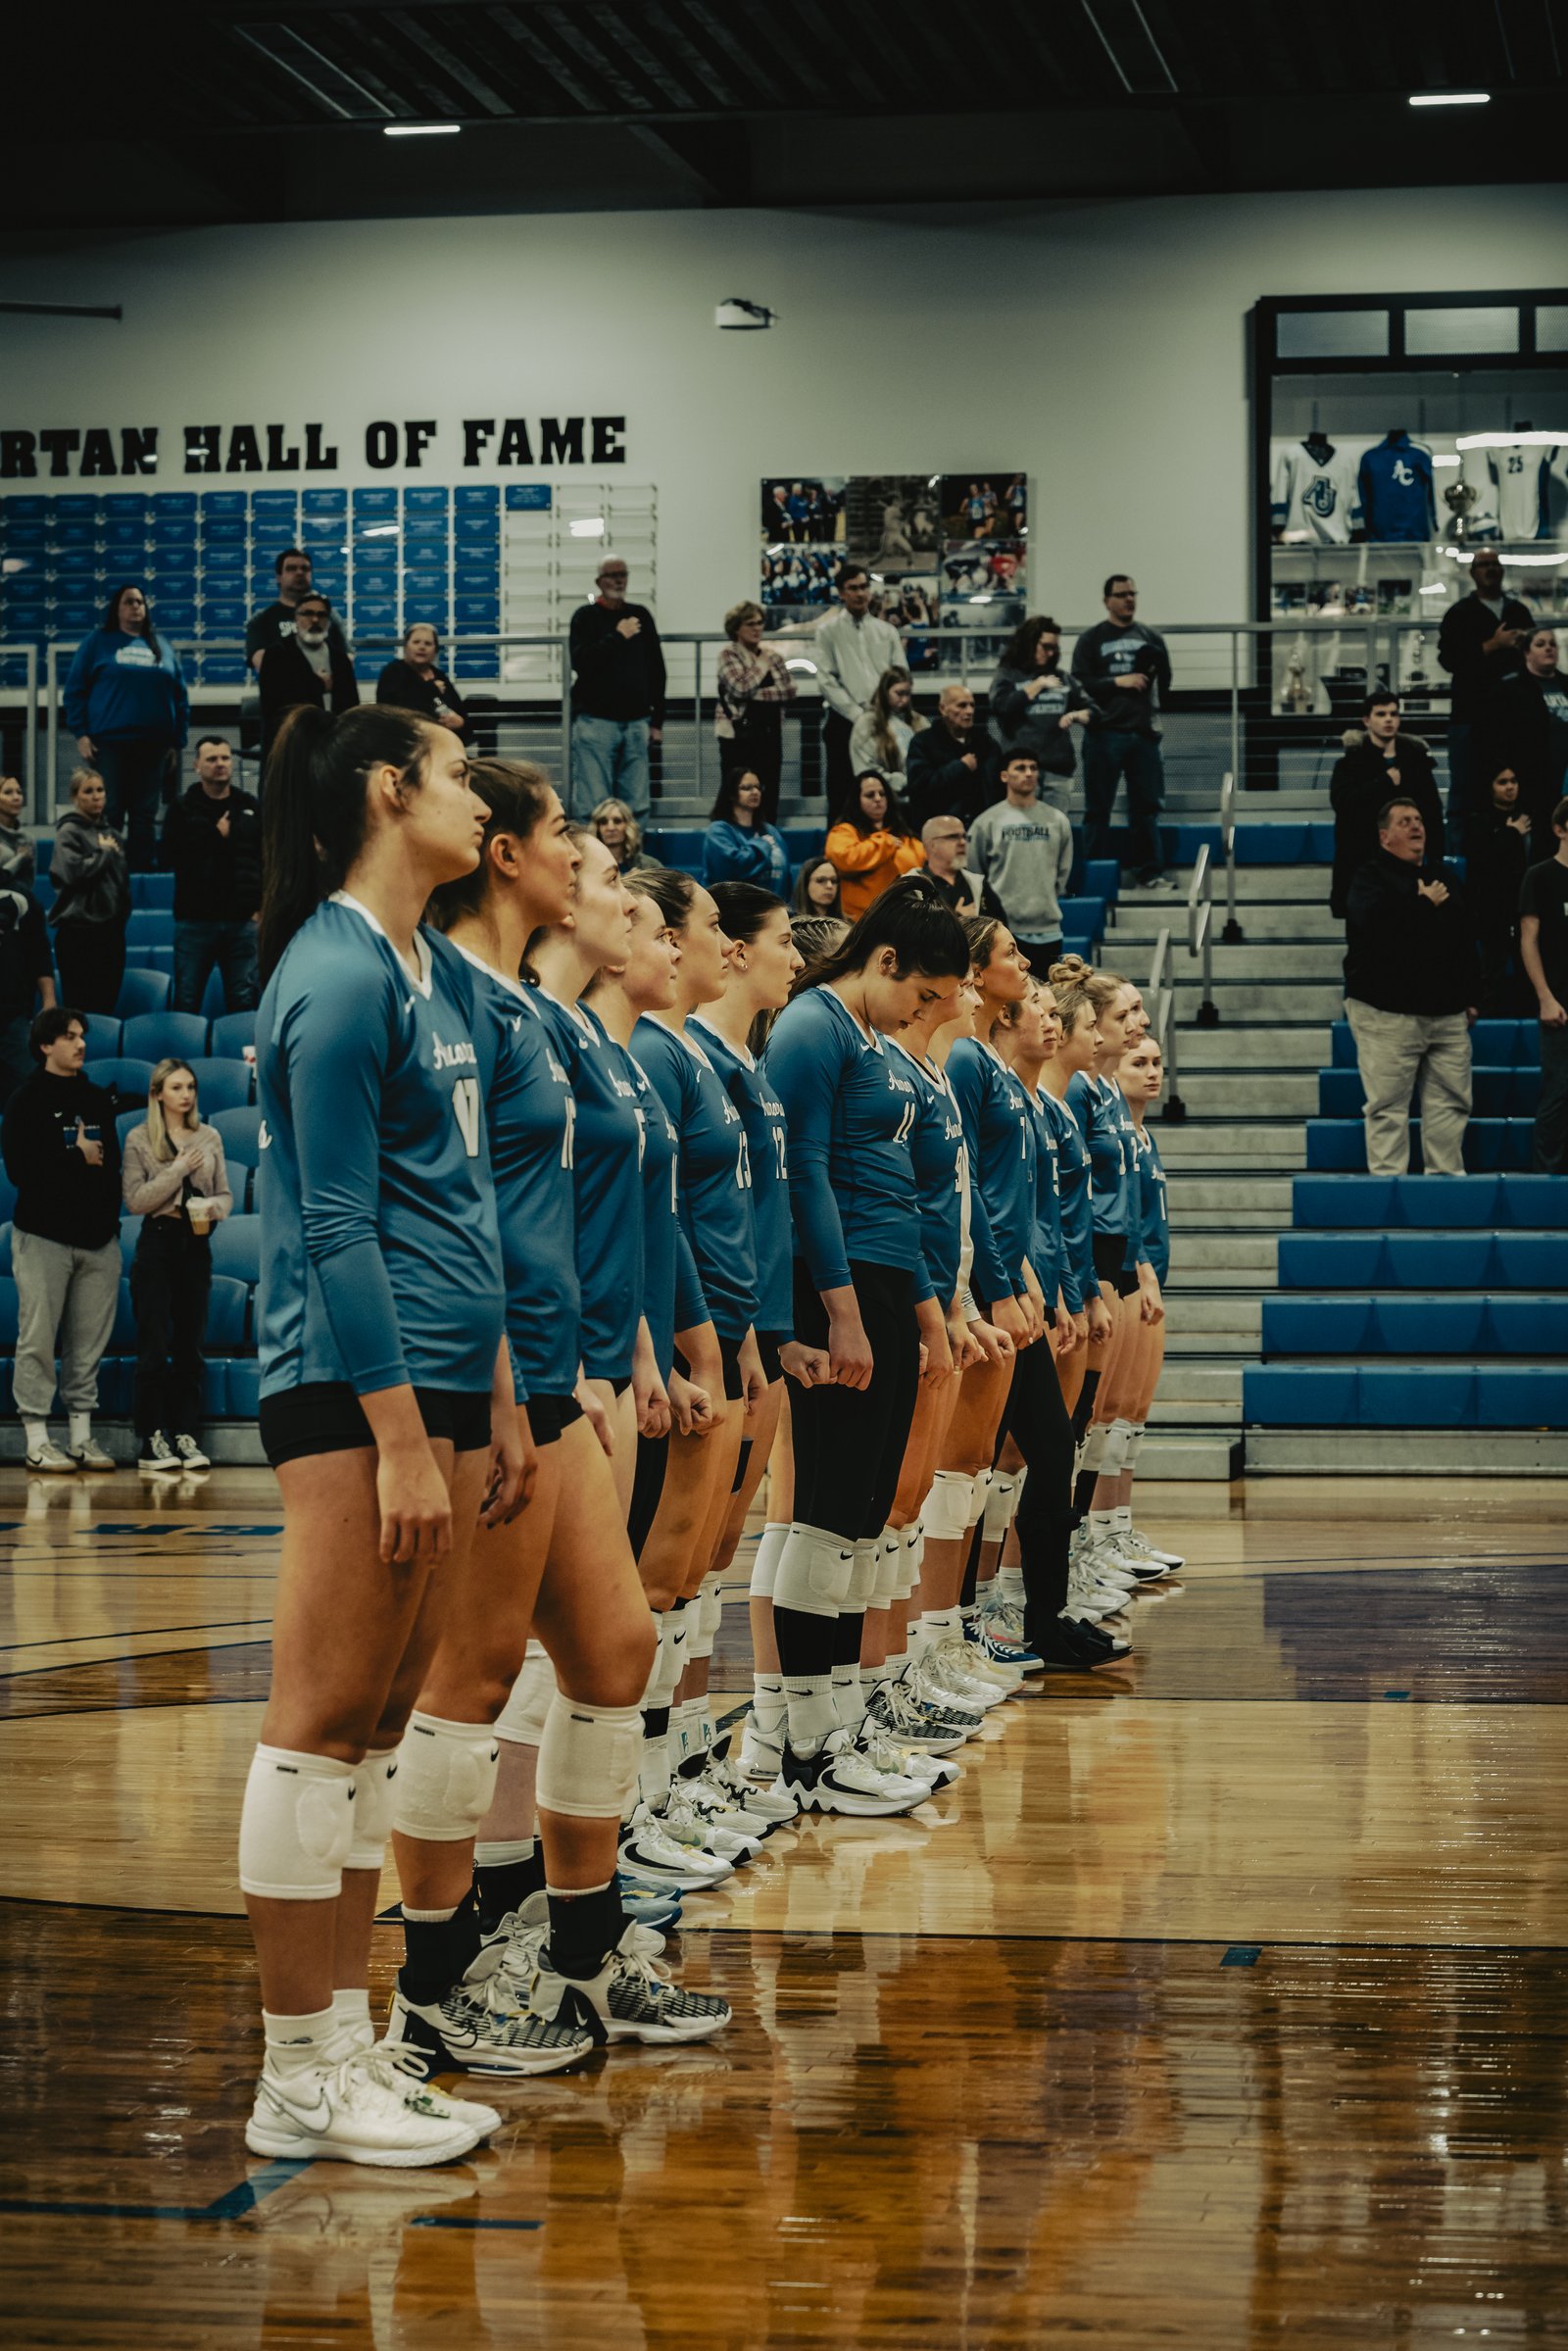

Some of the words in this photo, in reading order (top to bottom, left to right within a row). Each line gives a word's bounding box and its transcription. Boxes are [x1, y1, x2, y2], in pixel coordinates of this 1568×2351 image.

[183, 422, 338, 473] HALL
[366, 419, 438, 469] OF
[463, 416, 626, 467] FAME
[772, 1126, 788, 1180] 12
